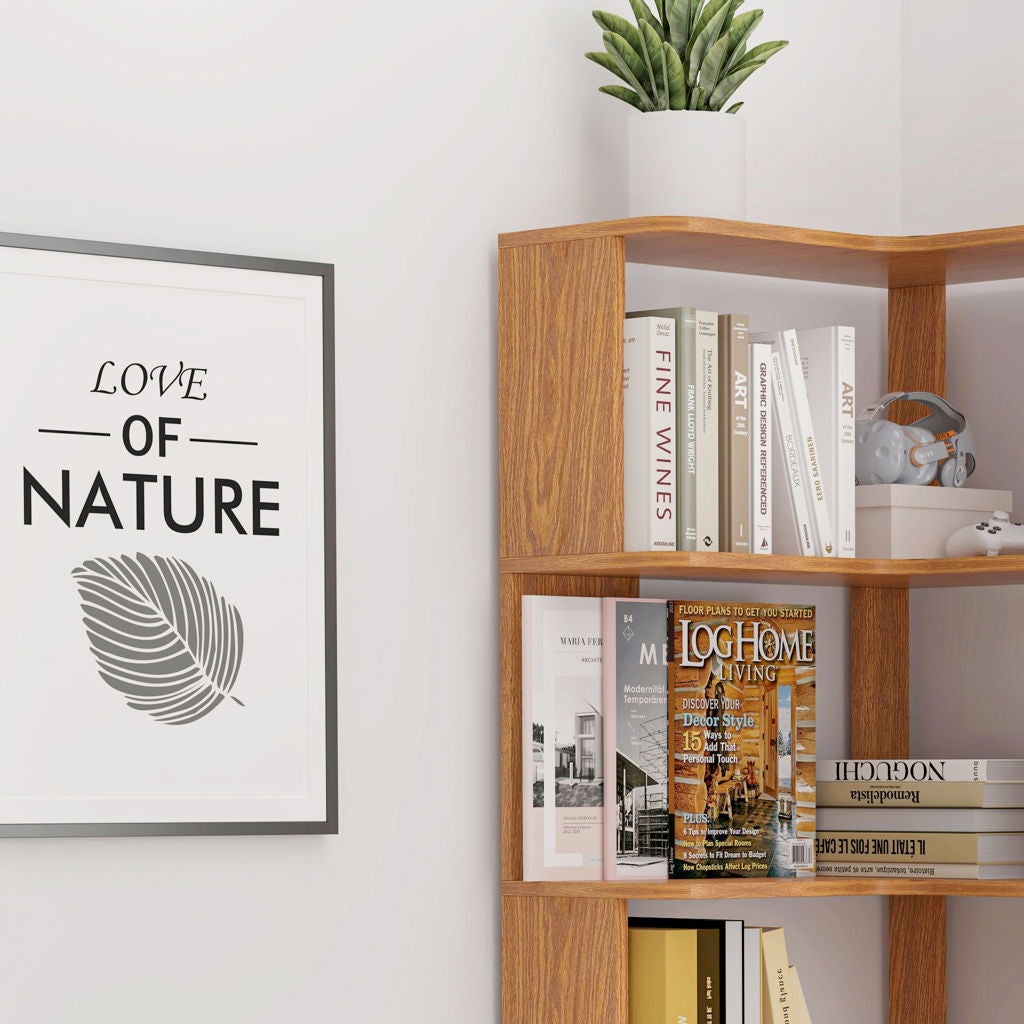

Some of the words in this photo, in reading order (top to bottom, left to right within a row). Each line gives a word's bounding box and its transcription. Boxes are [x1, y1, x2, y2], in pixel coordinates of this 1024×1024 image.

[90, 361, 208, 401] LOVE
[655, 349, 671, 413] FINE
[734, 370, 748, 409] ART
[759, 362, 767, 407] GRAPHIC
[687, 384, 696, 412] FRANK
[705, 384, 713, 411] Knitting
[841, 381, 855, 418] ART
[121, 414, 184, 458] OF
[687, 413, 696, 440] LLOYD
[759, 410, 767, 447] DESIGN
[687, 441, 696, 475] WRIGHT
[783, 433, 801, 488] BORDEAUX
[806, 436, 821, 479] SAARINEN
[655, 426, 672, 521] WINES
[759, 450, 767, 516] REFERENCED
[22, 465, 281, 537] NATURE
[815, 480, 824, 502] EERO
[678, 604, 704, 615] FLOOR
[706, 605, 731, 616] PLANS
[733, 606, 743, 617] TO
[745, 607, 760, 617] GET
[762, 608, 778, 618] YOU
[780, 608, 813, 618] STARTED
[560, 636, 586, 646] MARIA
[720, 665, 777, 682] LIVING
[682, 698, 719, 710] DISCOVER
[720, 698, 741, 710] YOUR
[683, 713, 719, 727] Decor
[722, 713, 754, 730] Style
[682, 730, 702, 751] 15
[703, 730, 722, 740] Ways
[724, 731, 732, 740] to
[704, 741, 720, 752] Add
[721, 741, 737, 752] That
[683, 753, 715, 764] Personal
[717, 753, 738, 764] Touch
[835, 761, 946, 782] NOGUCHI
[850, 789, 921, 804] Remodelista
[683, 813, 710, 824] PLUS:
[689, 828, 700, 836] Tips
[707, 828, 728, 836] Improve
[729, 827, 741, 836] Your
[742, 828, 760, 837] Design
[837, 838, 849, 854] LE
[850, 838, 870, 855] FOIS
[872, 838, 891, 855] UNE
[892, 838, 916, 858] ÉTAIT
[918, 839, 926, 855] IL
[724, 862, 740, 871] Affect
[741, 862, 751, 871] Log
[751, 862, 768, 870] Prices
